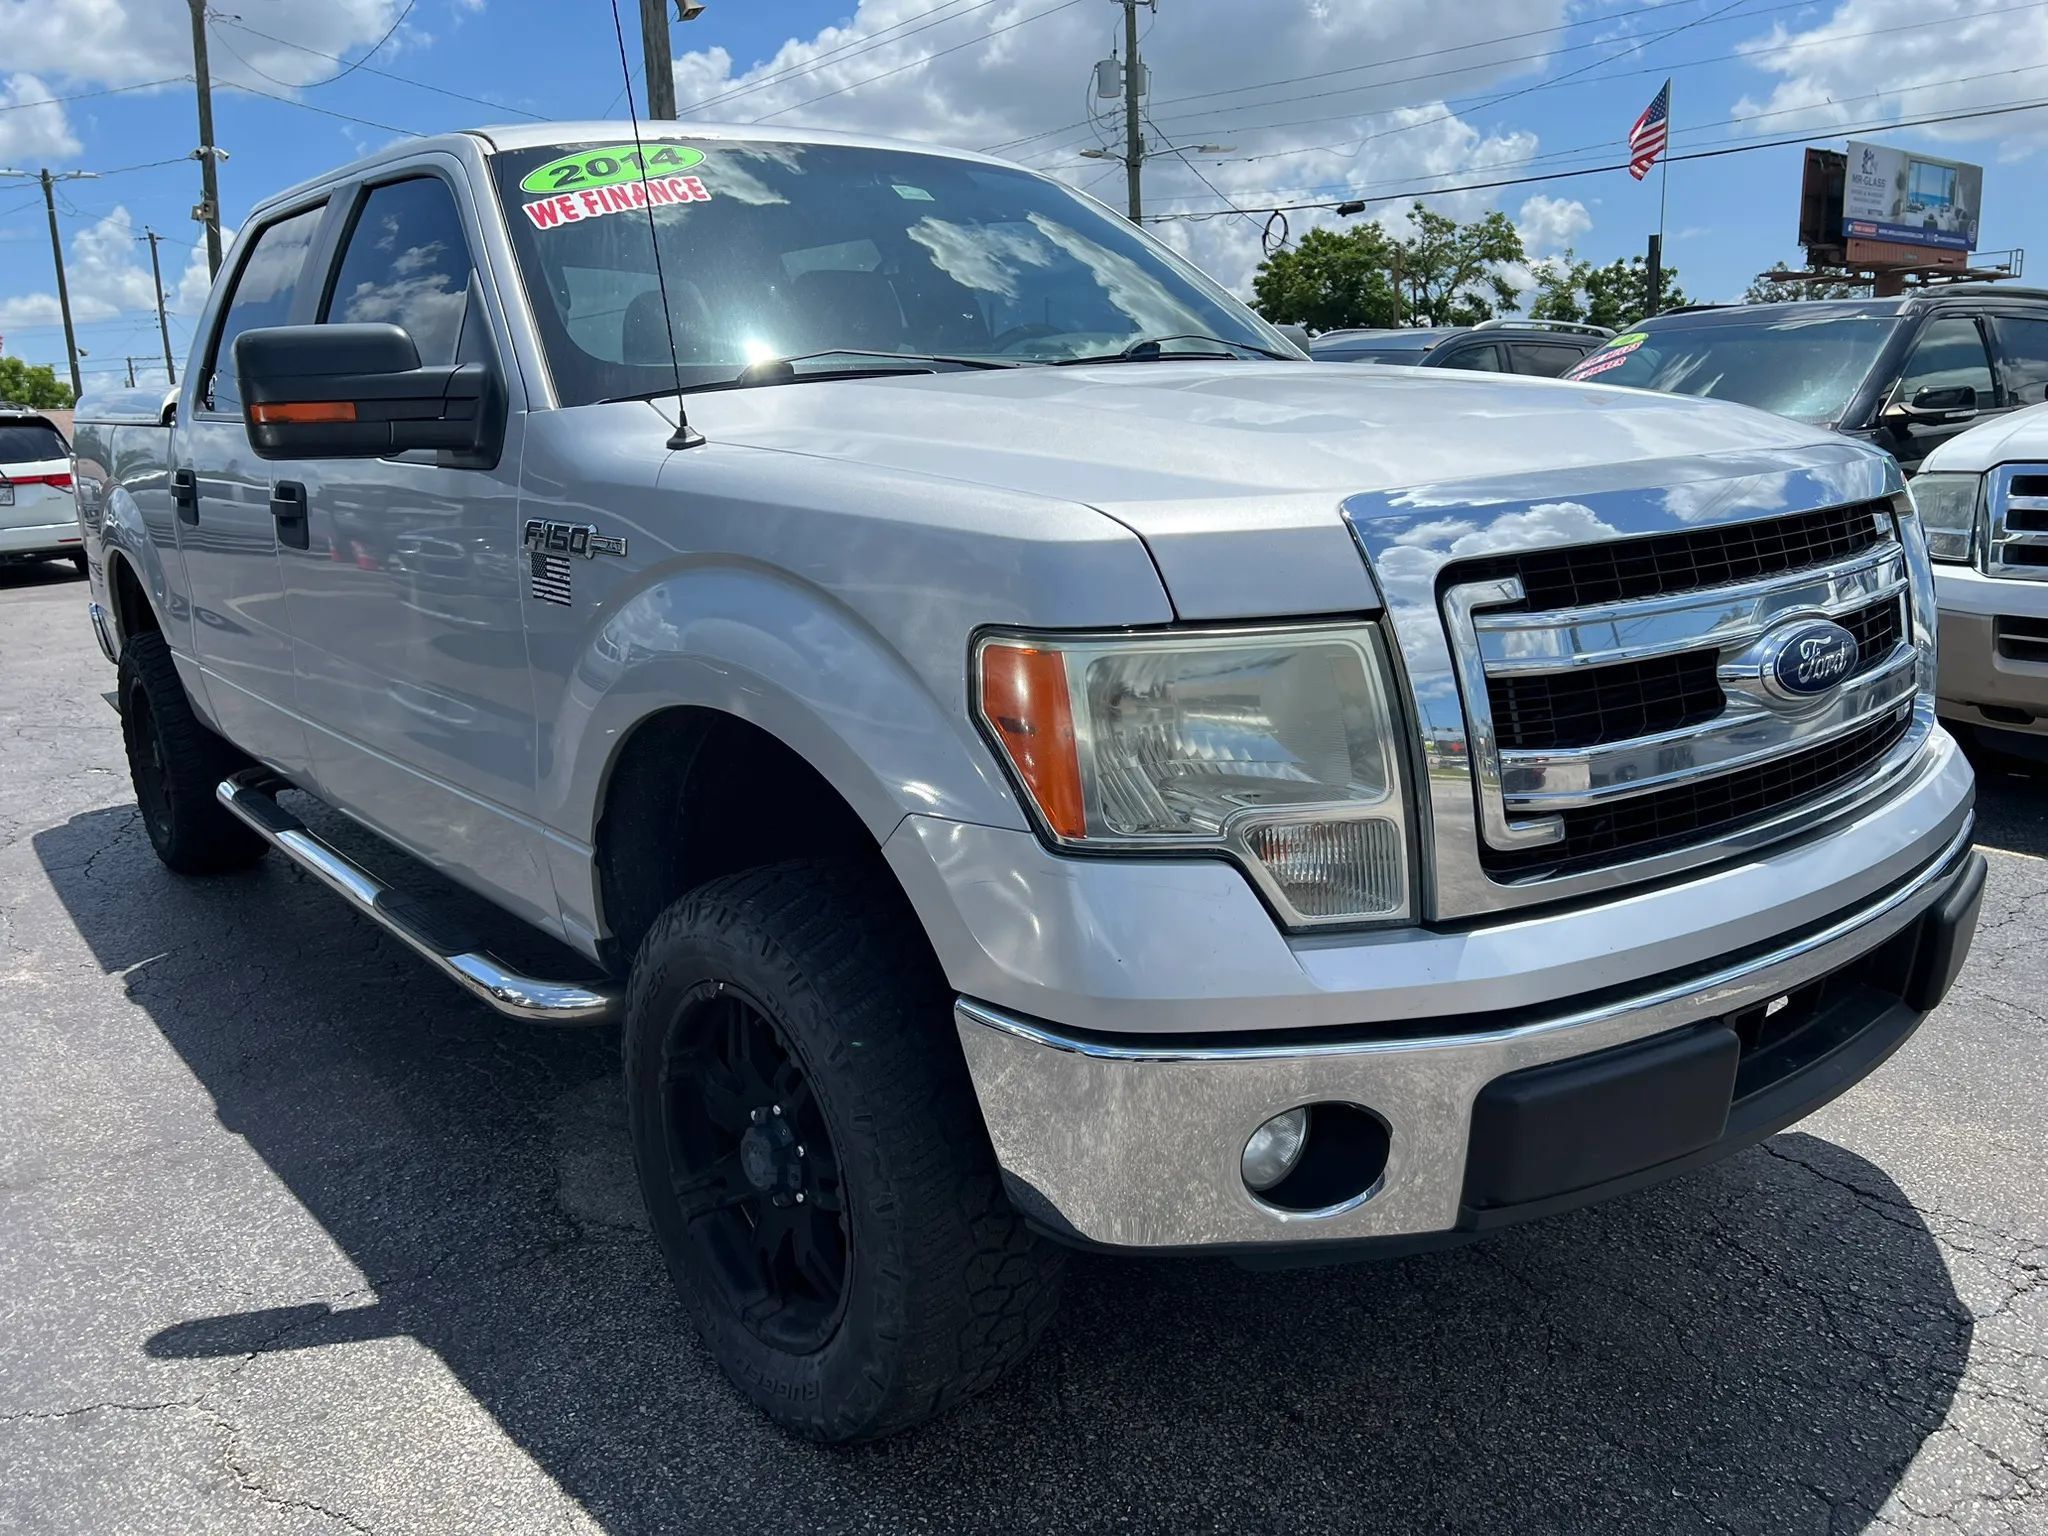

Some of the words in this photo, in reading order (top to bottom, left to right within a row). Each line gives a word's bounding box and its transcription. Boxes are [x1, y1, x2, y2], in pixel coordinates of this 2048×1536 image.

[549, 147, 686, 188] 2014
[527, 195, 580, 228] WE
[579, 177, 708, 215] FINANCE
[524, 519, 588, 554] F-150
[1798, 636, 1848, 684] Ford
